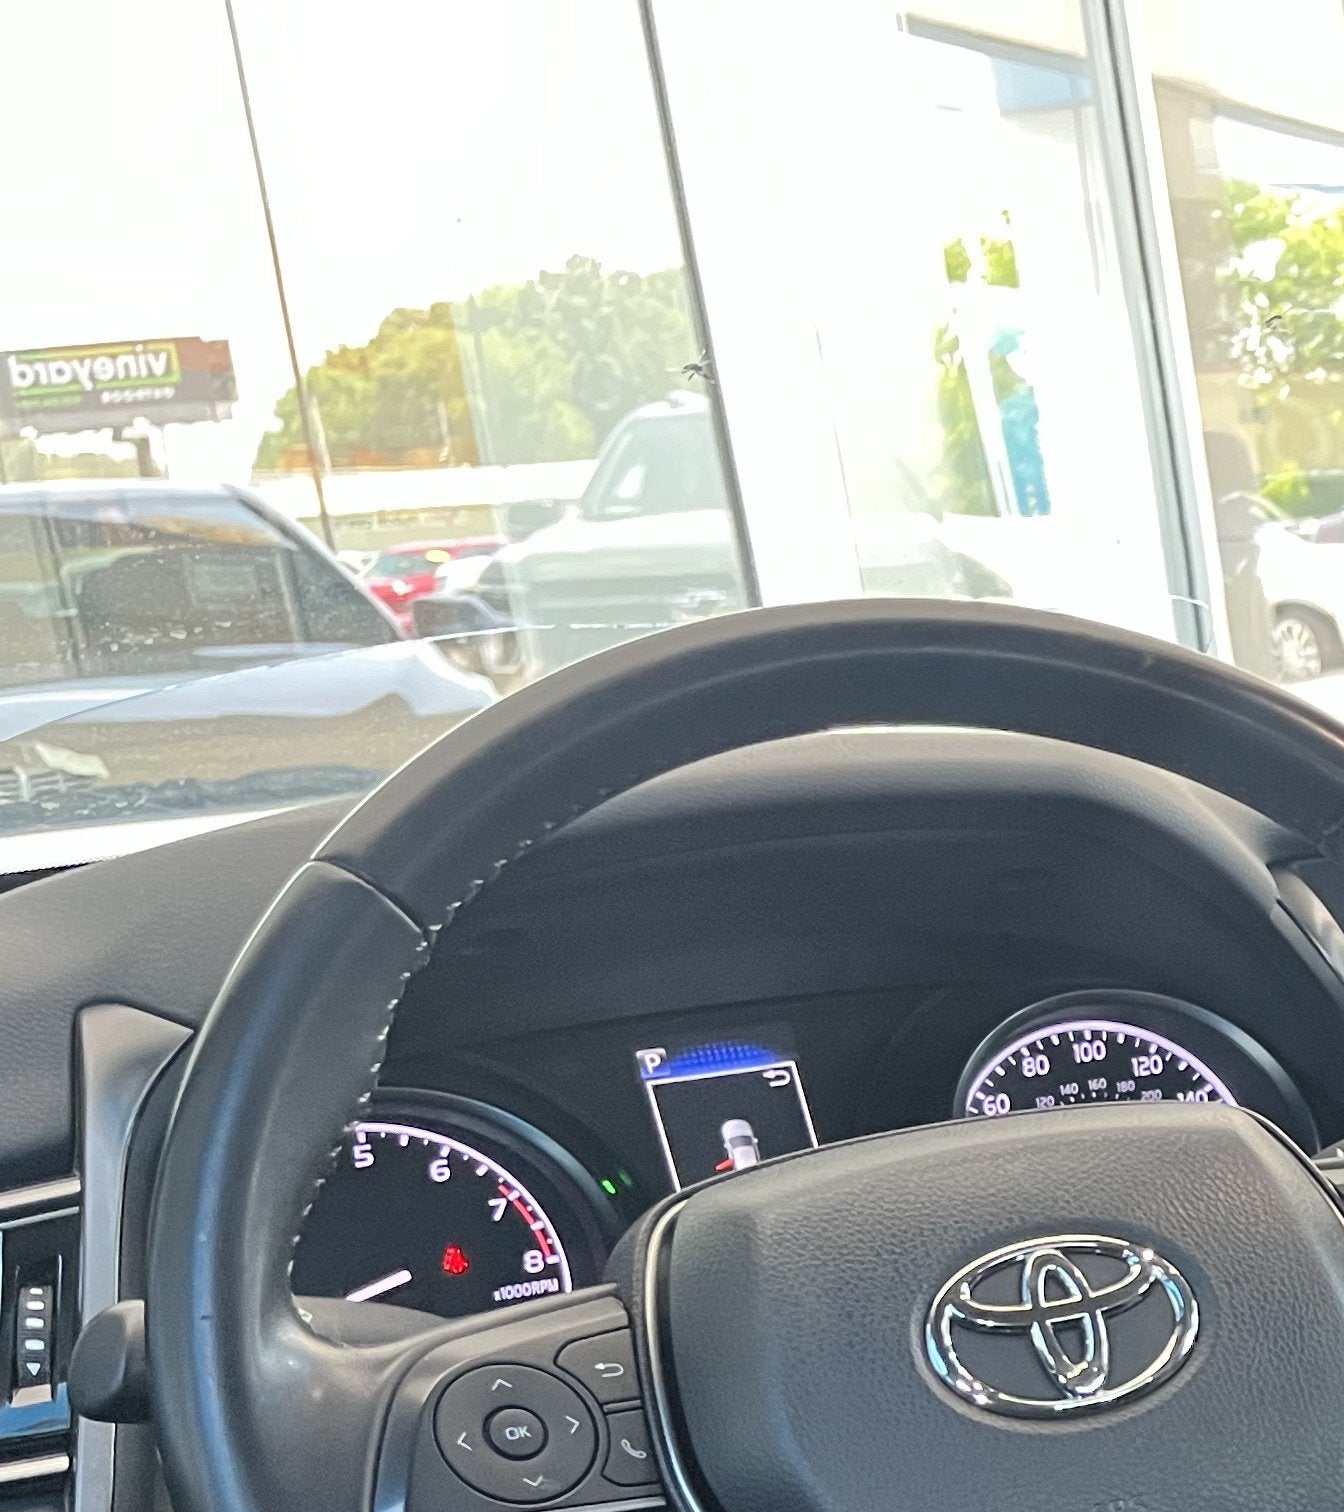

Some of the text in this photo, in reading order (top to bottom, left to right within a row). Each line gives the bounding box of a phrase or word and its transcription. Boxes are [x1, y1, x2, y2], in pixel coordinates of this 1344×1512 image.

[1072, 1040, 1107, 1064] 100
[1021, 1055, 1050, 1078] 80
[1130, 1054, 1163, 1077] 120
[1059, 1083, 1079, 1096] 140
[1088, 1078, 1107, 1091] 160
[982, 1093, 1011, 1116] 60
[353, 1144, 374, 1169] 5
[429, 1159, 451, 1183] 6
[487, 1197, 507, 1222] 7
[522, 1249, 545, 1274] 8
[504, 1425, 532, 1440] OK
